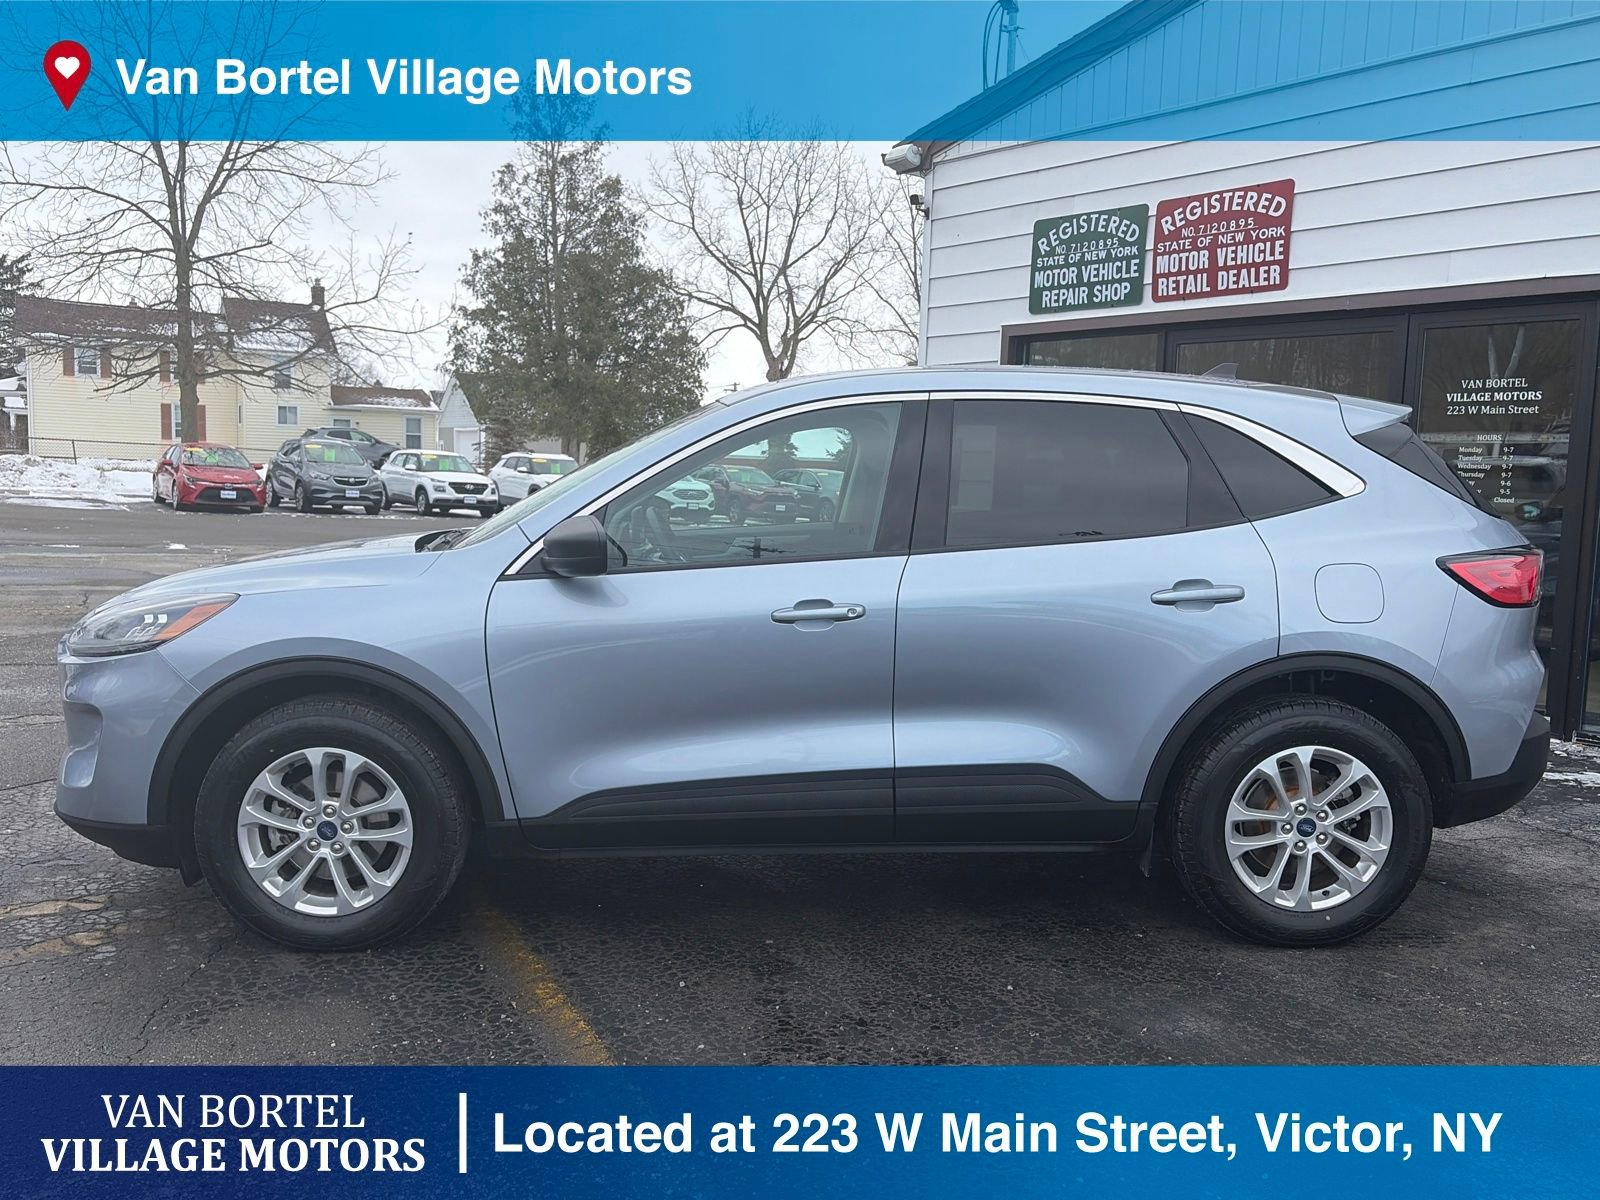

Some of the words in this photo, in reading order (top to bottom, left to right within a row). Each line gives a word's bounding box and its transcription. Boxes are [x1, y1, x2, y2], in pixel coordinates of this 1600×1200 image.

[1161, 192, 1286, 235] REGISTERED
[1038, 214, 1139, 255] REGISTERED
[1157, 239, 1192, 252] STATE
[1198, 236, 1213, 247] OF
[1218, 232, 1245, 244] NEW
[1250, 226, 1285, 240] YORK
[1037, 256, 1064, 267] STATE
[1069, 253, 1081, 263] OF
[1084, 250, 1107, 261] NEW
[1110, 246, 1138, 258] YORK
[1156, 250, 1209, 274] MOTOR
[1217, 240, 1284, 267] VEHICLE
[1034, 267, 1077, 288] MOTOR
[1082, 259, 1139, 282] VEHICLE
[1158, 273, 1210, 296] RETAIL
[1218, 265, 1280, 290] DEALER
[1042, 287, 1088, 308] REPAIR
[1093, 282, 1130, 303] SHOP
[1462, 380, 1483, 388] VAN
[1486, 378, 1528, 388] BORTEL
[1447, 392, 1491, 402] VILLAGE
[1494, 391, 1542, 401] MOTORS
[1447, 406, 1465, 415] 223
[1468, 406, 1479, 414] W
[1481, 405, 1505, 414] Main
[1508, 405, 1539, 414] Street
[1459, 446, 1482, 454] Monday
